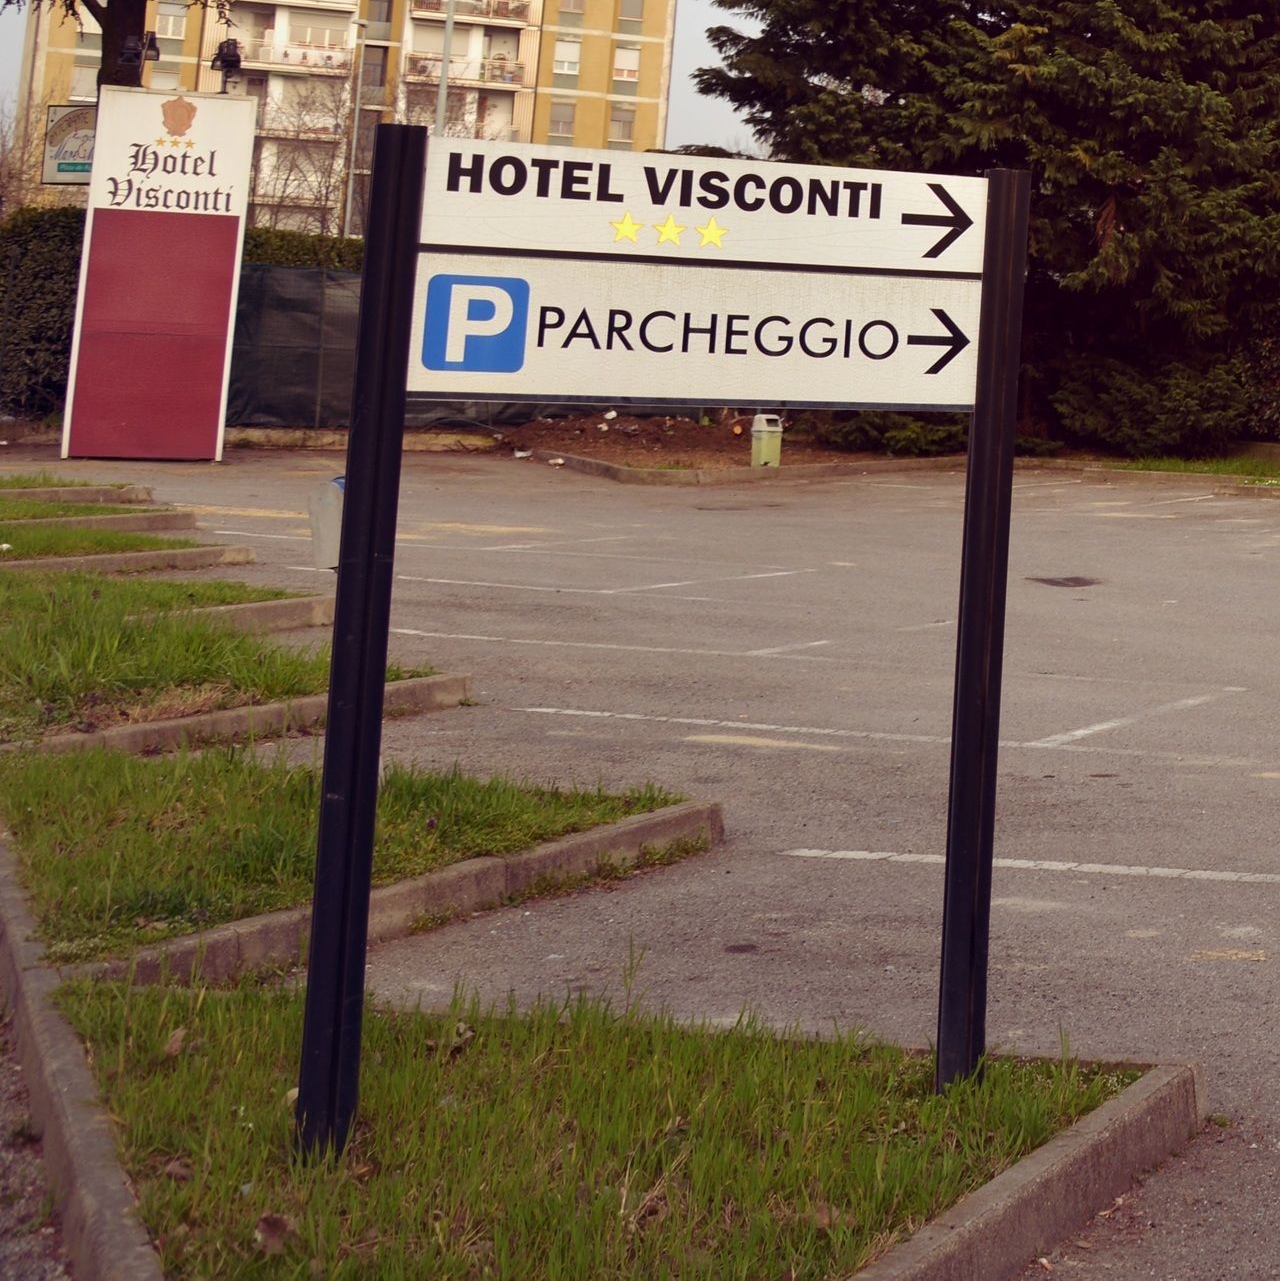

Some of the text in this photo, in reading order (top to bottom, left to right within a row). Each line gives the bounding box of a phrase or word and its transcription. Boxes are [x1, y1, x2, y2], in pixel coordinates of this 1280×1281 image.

[127, 142, 218, 179] Hotel
[446, 151, 883, 220] HOTEL VISCONTI
[106, 176, 234, 213] Visconti
[443, 284, 899, 363] P PARCHEGGIO
